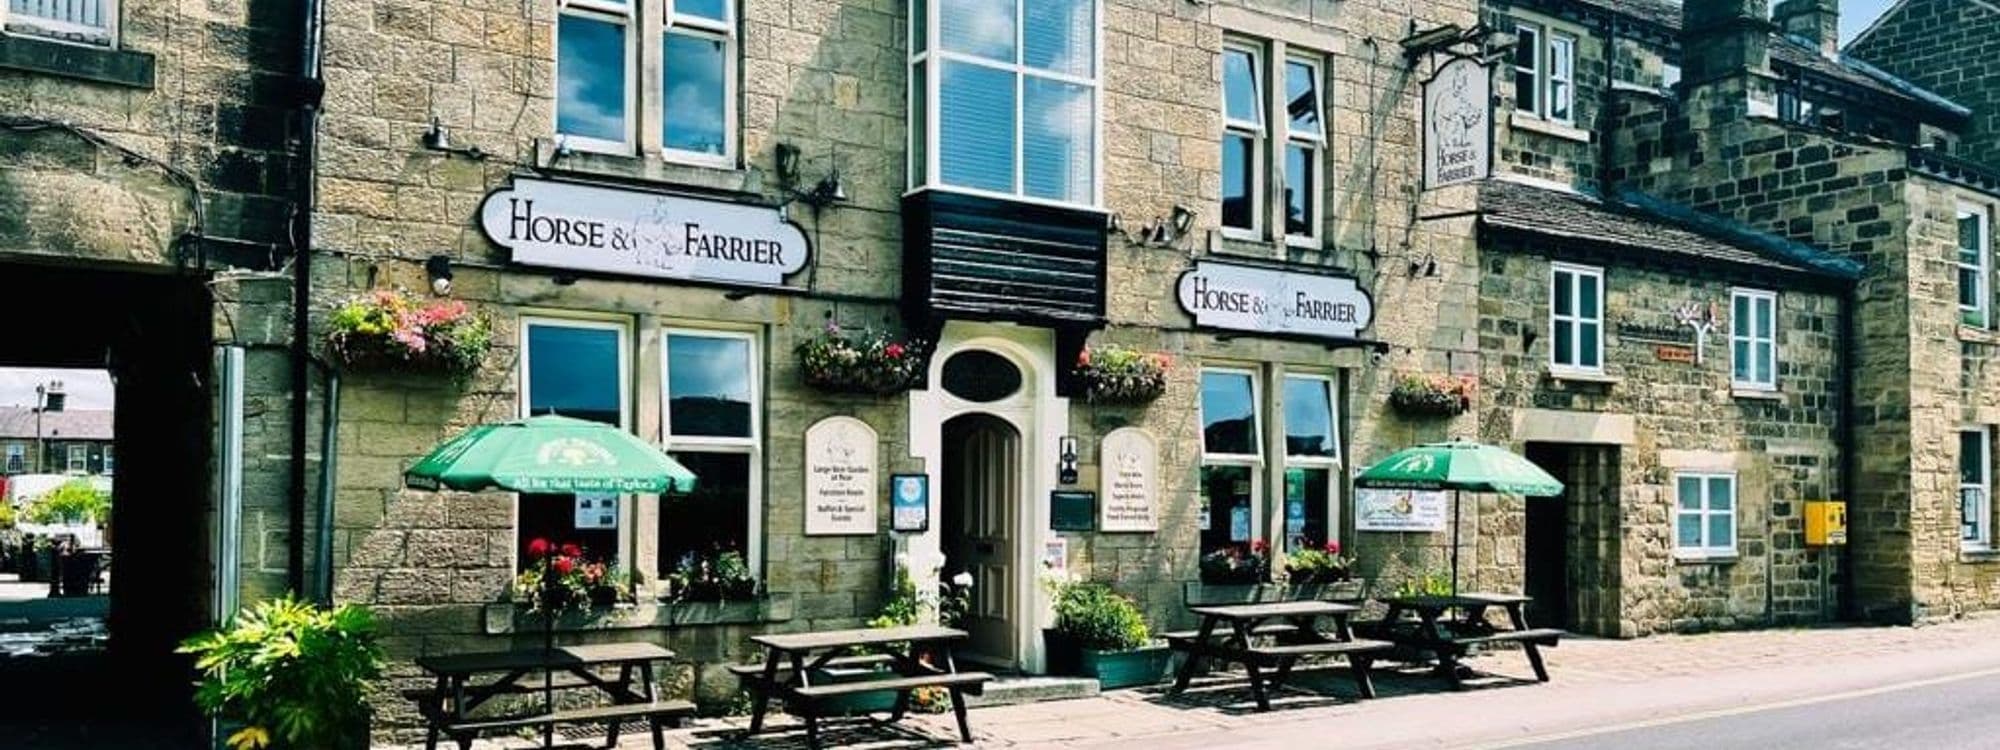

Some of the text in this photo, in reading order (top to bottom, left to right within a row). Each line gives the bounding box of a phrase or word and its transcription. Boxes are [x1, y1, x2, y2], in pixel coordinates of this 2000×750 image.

[508, 199, 786, 266] HORSE & FARRIER
[1193, 276, 1357, 323] HORSE & FARRIER
